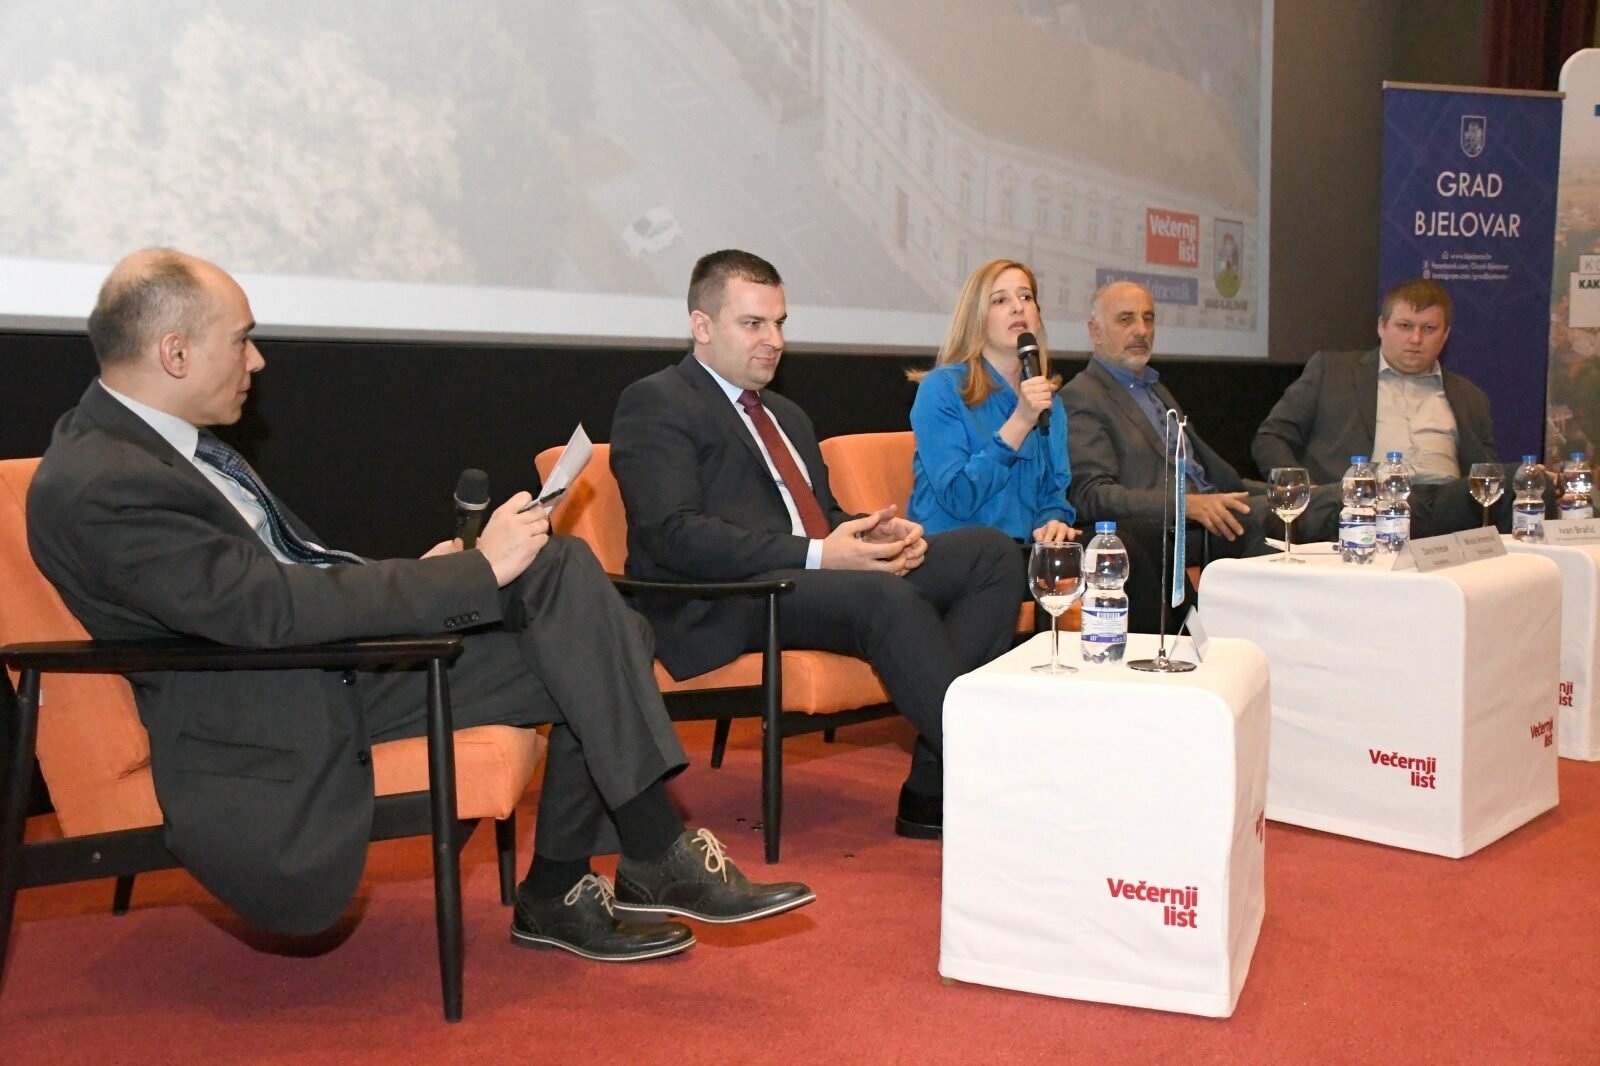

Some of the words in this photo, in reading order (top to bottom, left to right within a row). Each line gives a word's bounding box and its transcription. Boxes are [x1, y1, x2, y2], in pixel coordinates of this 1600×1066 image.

[1436, 171, 1503, 198] GRAD
[1149, 214, 1197, 242] Večernji
[1414, 211, 1521, 238] BJELOVAR
[1179, 239, 1196, 263] list
[1559, 693, 1573, 707] ist
[1369, 749, 1436, 773] Večernji
[1410, 772, 1436, 789] list
[1106, 877, 1199, 910] Večernji
[1163, 905, 1198, 929] list
